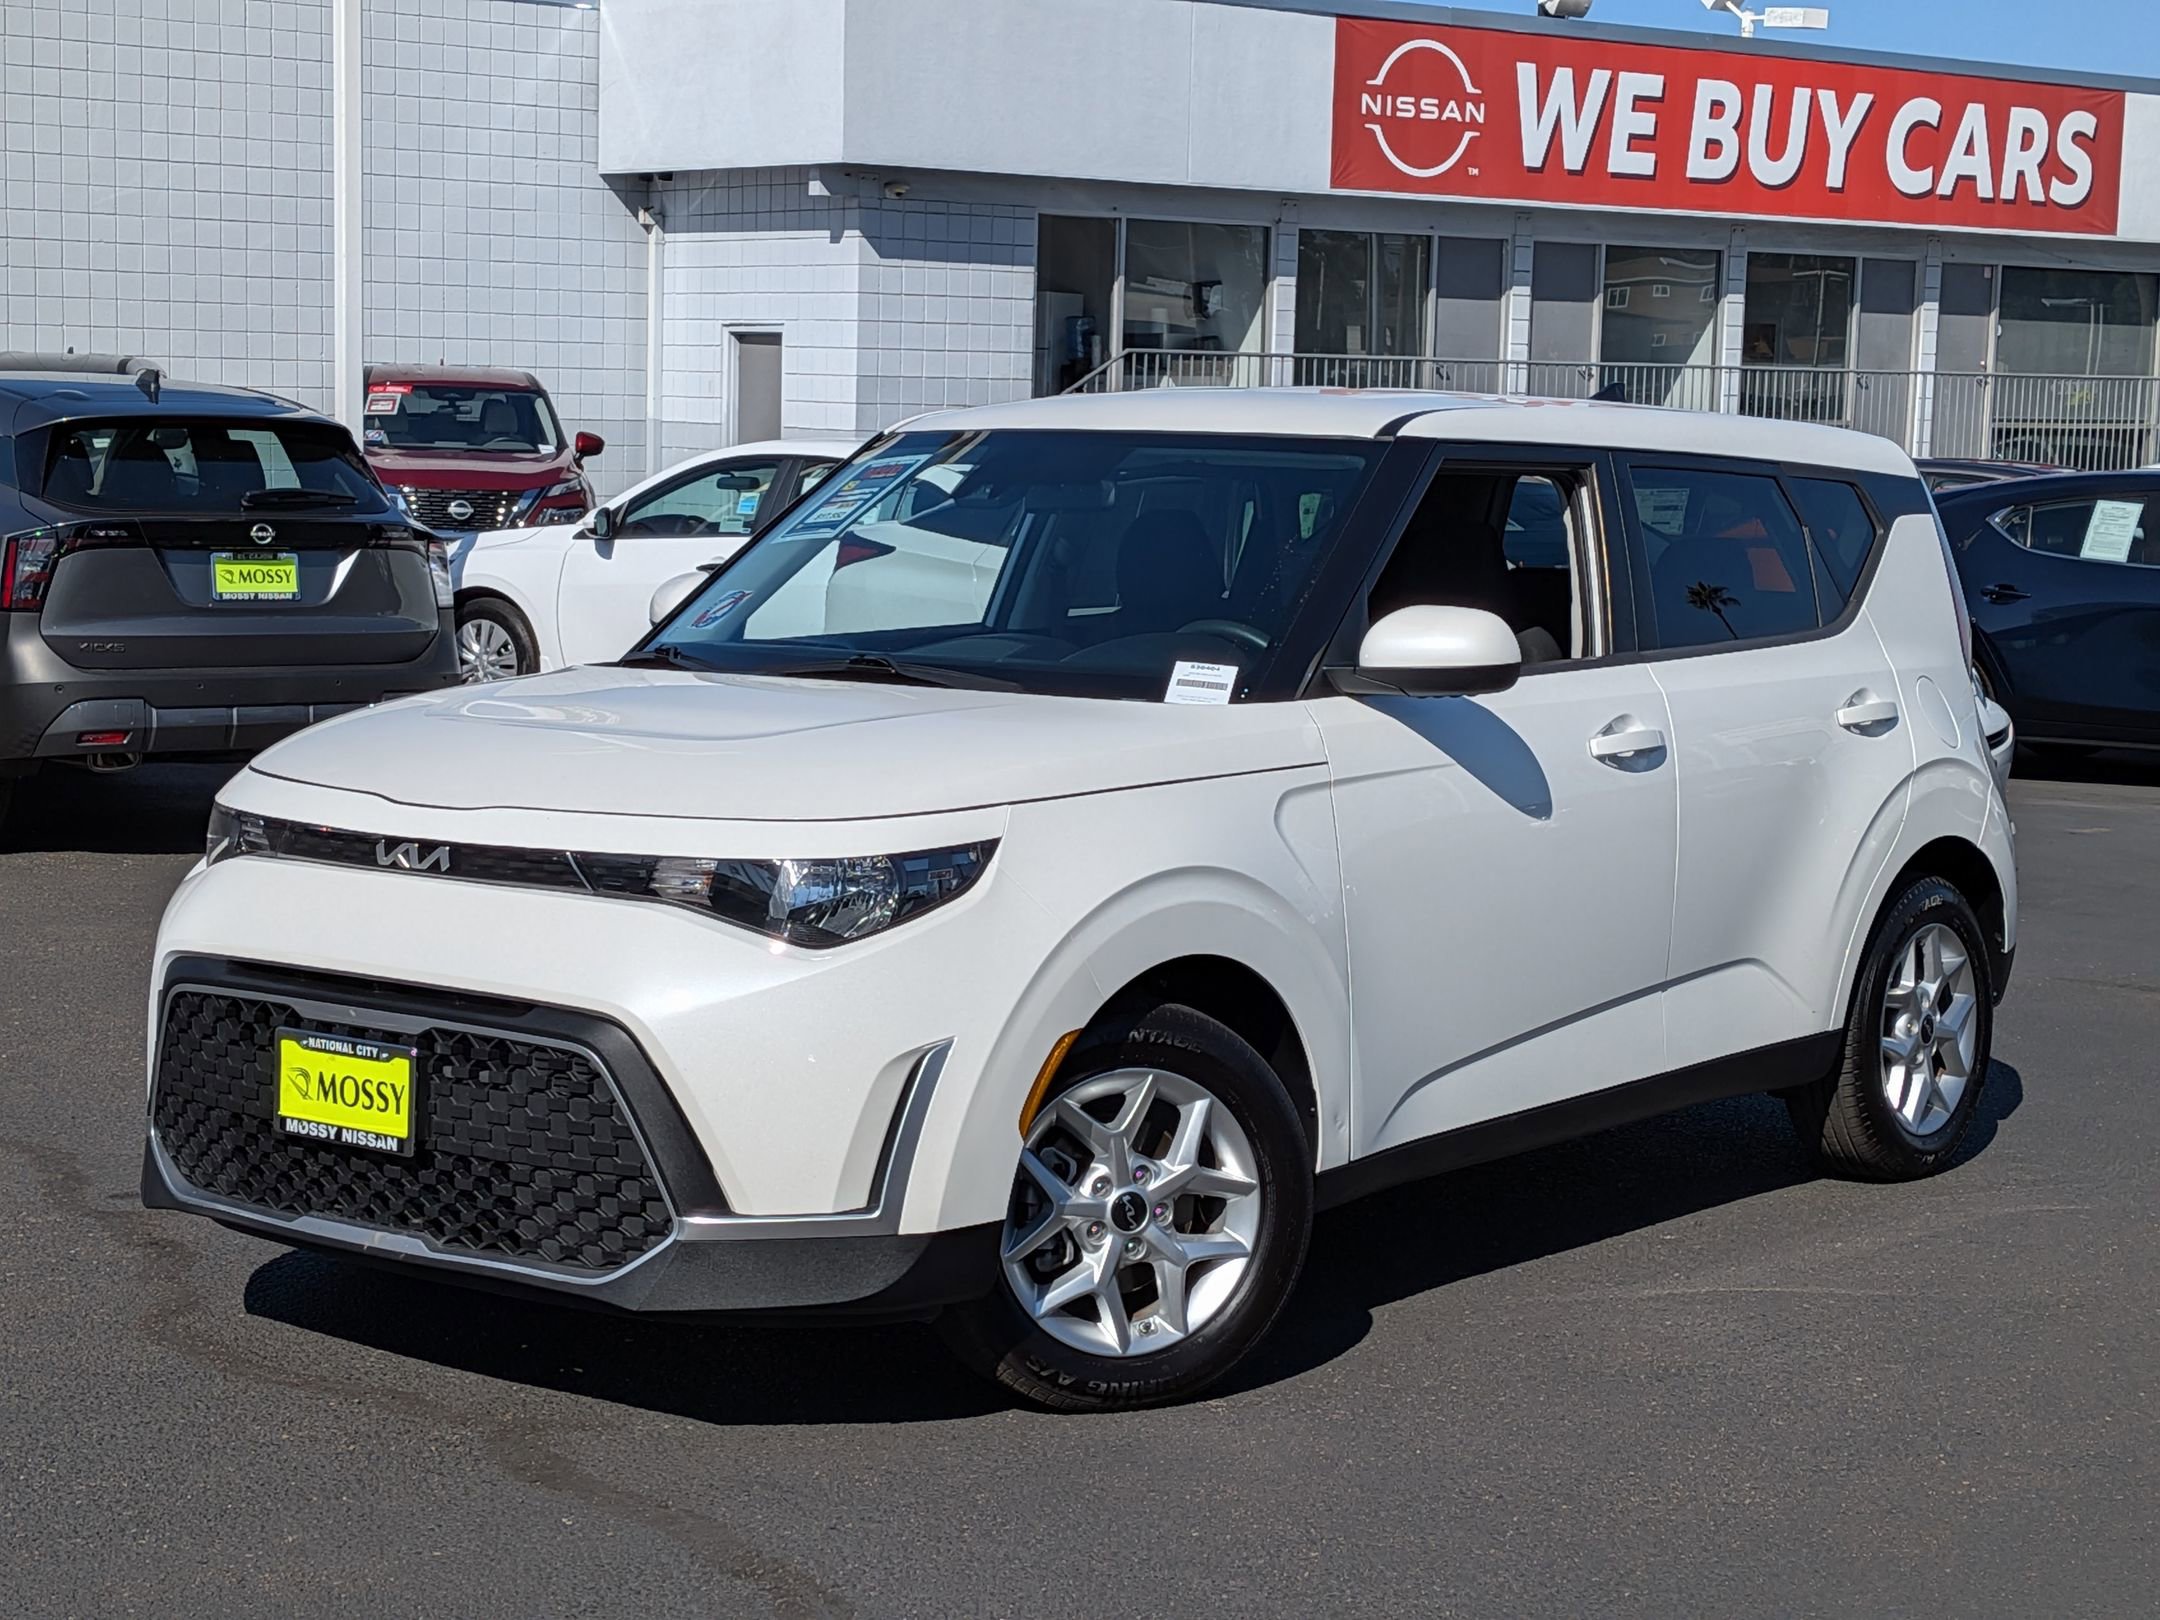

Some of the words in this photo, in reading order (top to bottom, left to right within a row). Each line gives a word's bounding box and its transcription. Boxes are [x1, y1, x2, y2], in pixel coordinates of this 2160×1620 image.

[1361, 93, 1485, 124] NISSAN
[1515, 61, 1665, 179] WE
[1685, 78, 1875, 190] BUY
[1885, 97, 2098, 207] CARS
[238, 569, 293, 584] MOSSY
[222, 592, 255, 600] MOSSY
[308, 1037, 354, 1054] NATIONAL
[356, 1045, 379, 1058] CITY
[316, 1071, 406, 1115] MOSSY
[285, 1118, 338, 1139] MOSSY
[341, 1129, 398, 1151] NISSAN
